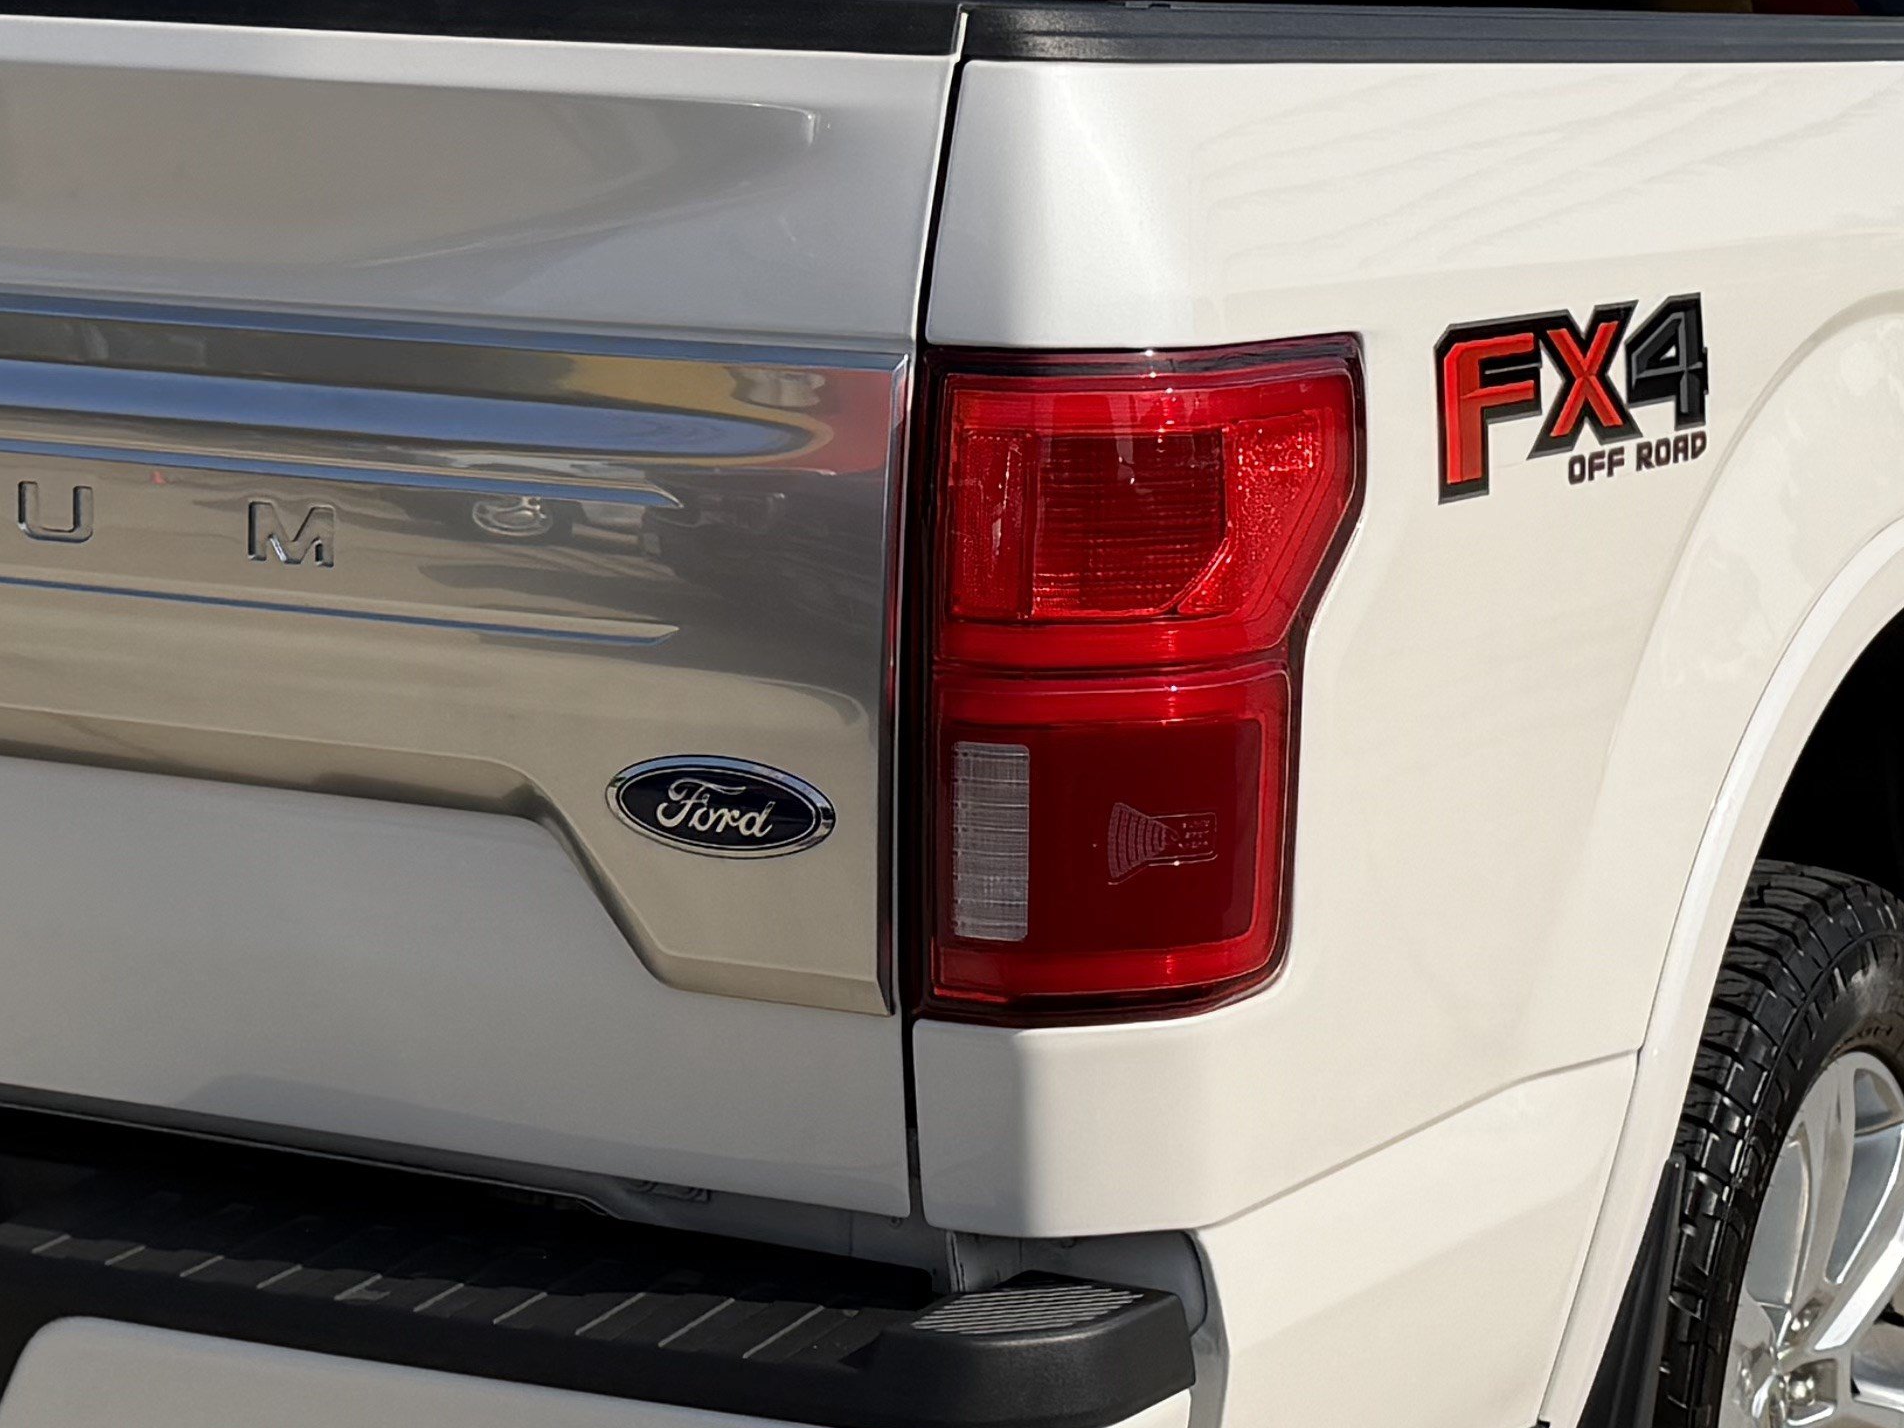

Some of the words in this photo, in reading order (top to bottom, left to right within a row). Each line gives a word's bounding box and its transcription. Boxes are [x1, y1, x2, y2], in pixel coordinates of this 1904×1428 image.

[1434, 292, 1708, 505] FX4
[1568, 446, 1625, 485] OFF
[1636, 431, 1707, 471] ROAD
[656, 777, 776, 838] Ford
